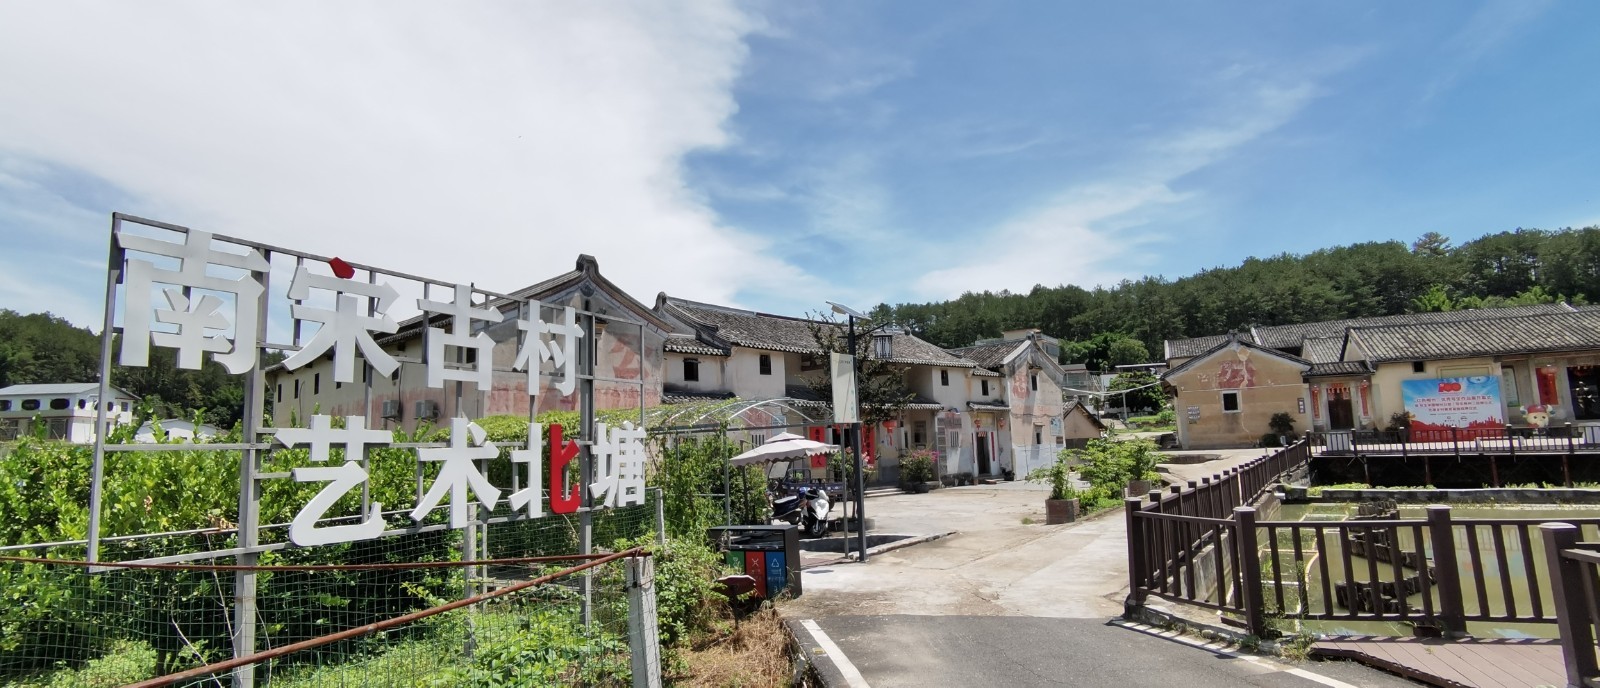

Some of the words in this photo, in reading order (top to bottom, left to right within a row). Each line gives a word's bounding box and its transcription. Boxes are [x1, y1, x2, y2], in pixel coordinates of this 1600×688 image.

[115, 229, 584, 396] 南宋古村
[274, 413, 646, 547] 艺术北塘
